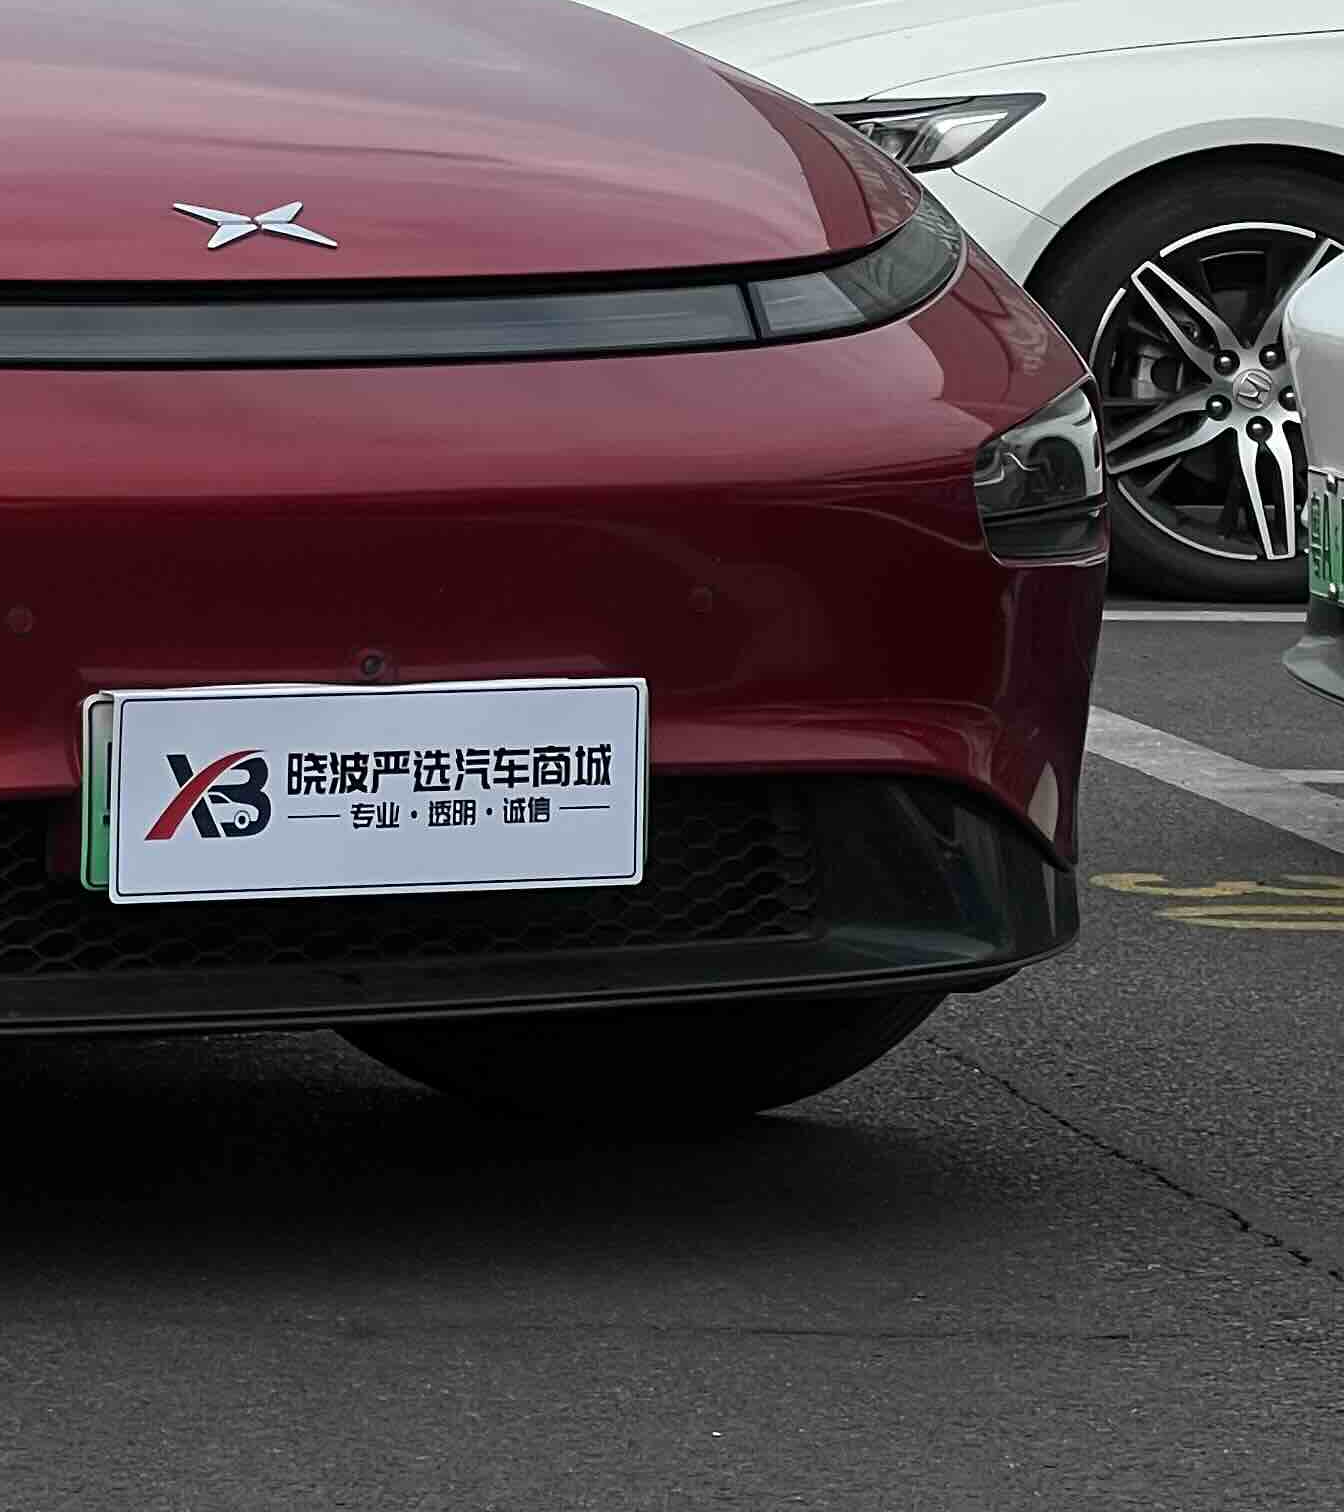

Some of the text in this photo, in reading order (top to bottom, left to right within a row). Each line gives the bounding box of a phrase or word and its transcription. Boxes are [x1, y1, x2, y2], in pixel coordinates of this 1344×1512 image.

[287, 743, 612, 795] 晓波严选汽车商城
